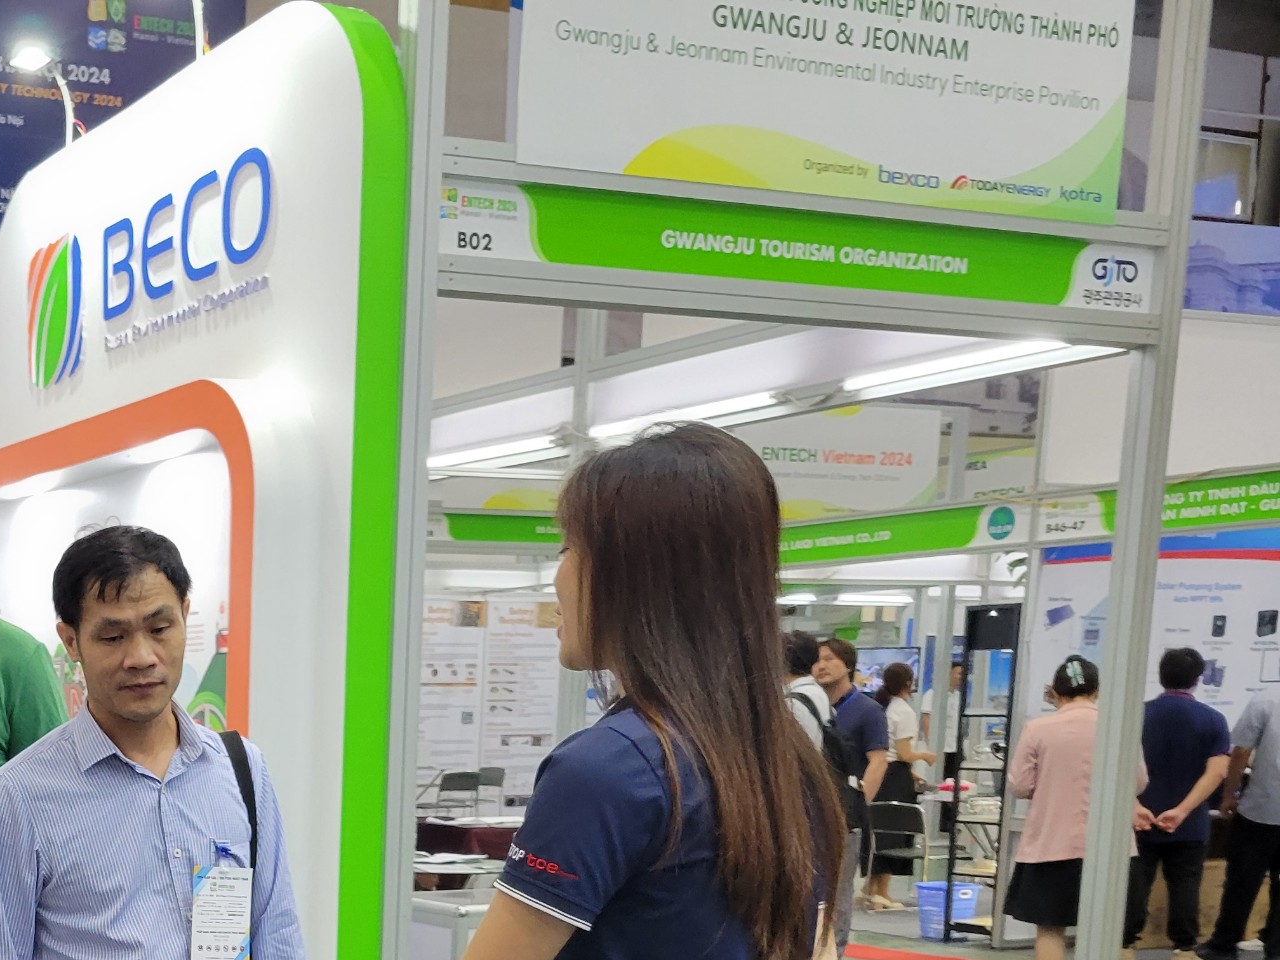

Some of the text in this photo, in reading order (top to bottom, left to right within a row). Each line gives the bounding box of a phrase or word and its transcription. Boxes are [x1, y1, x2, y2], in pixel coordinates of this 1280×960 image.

[712, 4, 969, 62] GWANGJU & JEONNAM
[955, 3, 1025, 35] TRƯỜNG
[1030, 12, 1083, 44] THÀNH
[68, 65, 111, 84] 2024
[555, 19, 1100, 111] Gwangju & Jeonnam Environmental Industry Enterprise Pavilion
[93, 96, 123, 107] 2024
[877, 164, 939, 189] bexco
[1059, 185, 1103, 204] kotra
[104, 147, 271, 321] BECO
[457, 231, 492, 251] B02
[661, 229, 968, 274] GWANGJU TOURISM ORGANIZATION
[762, 446, 913, 467] ENTECH Vietnam 2024
